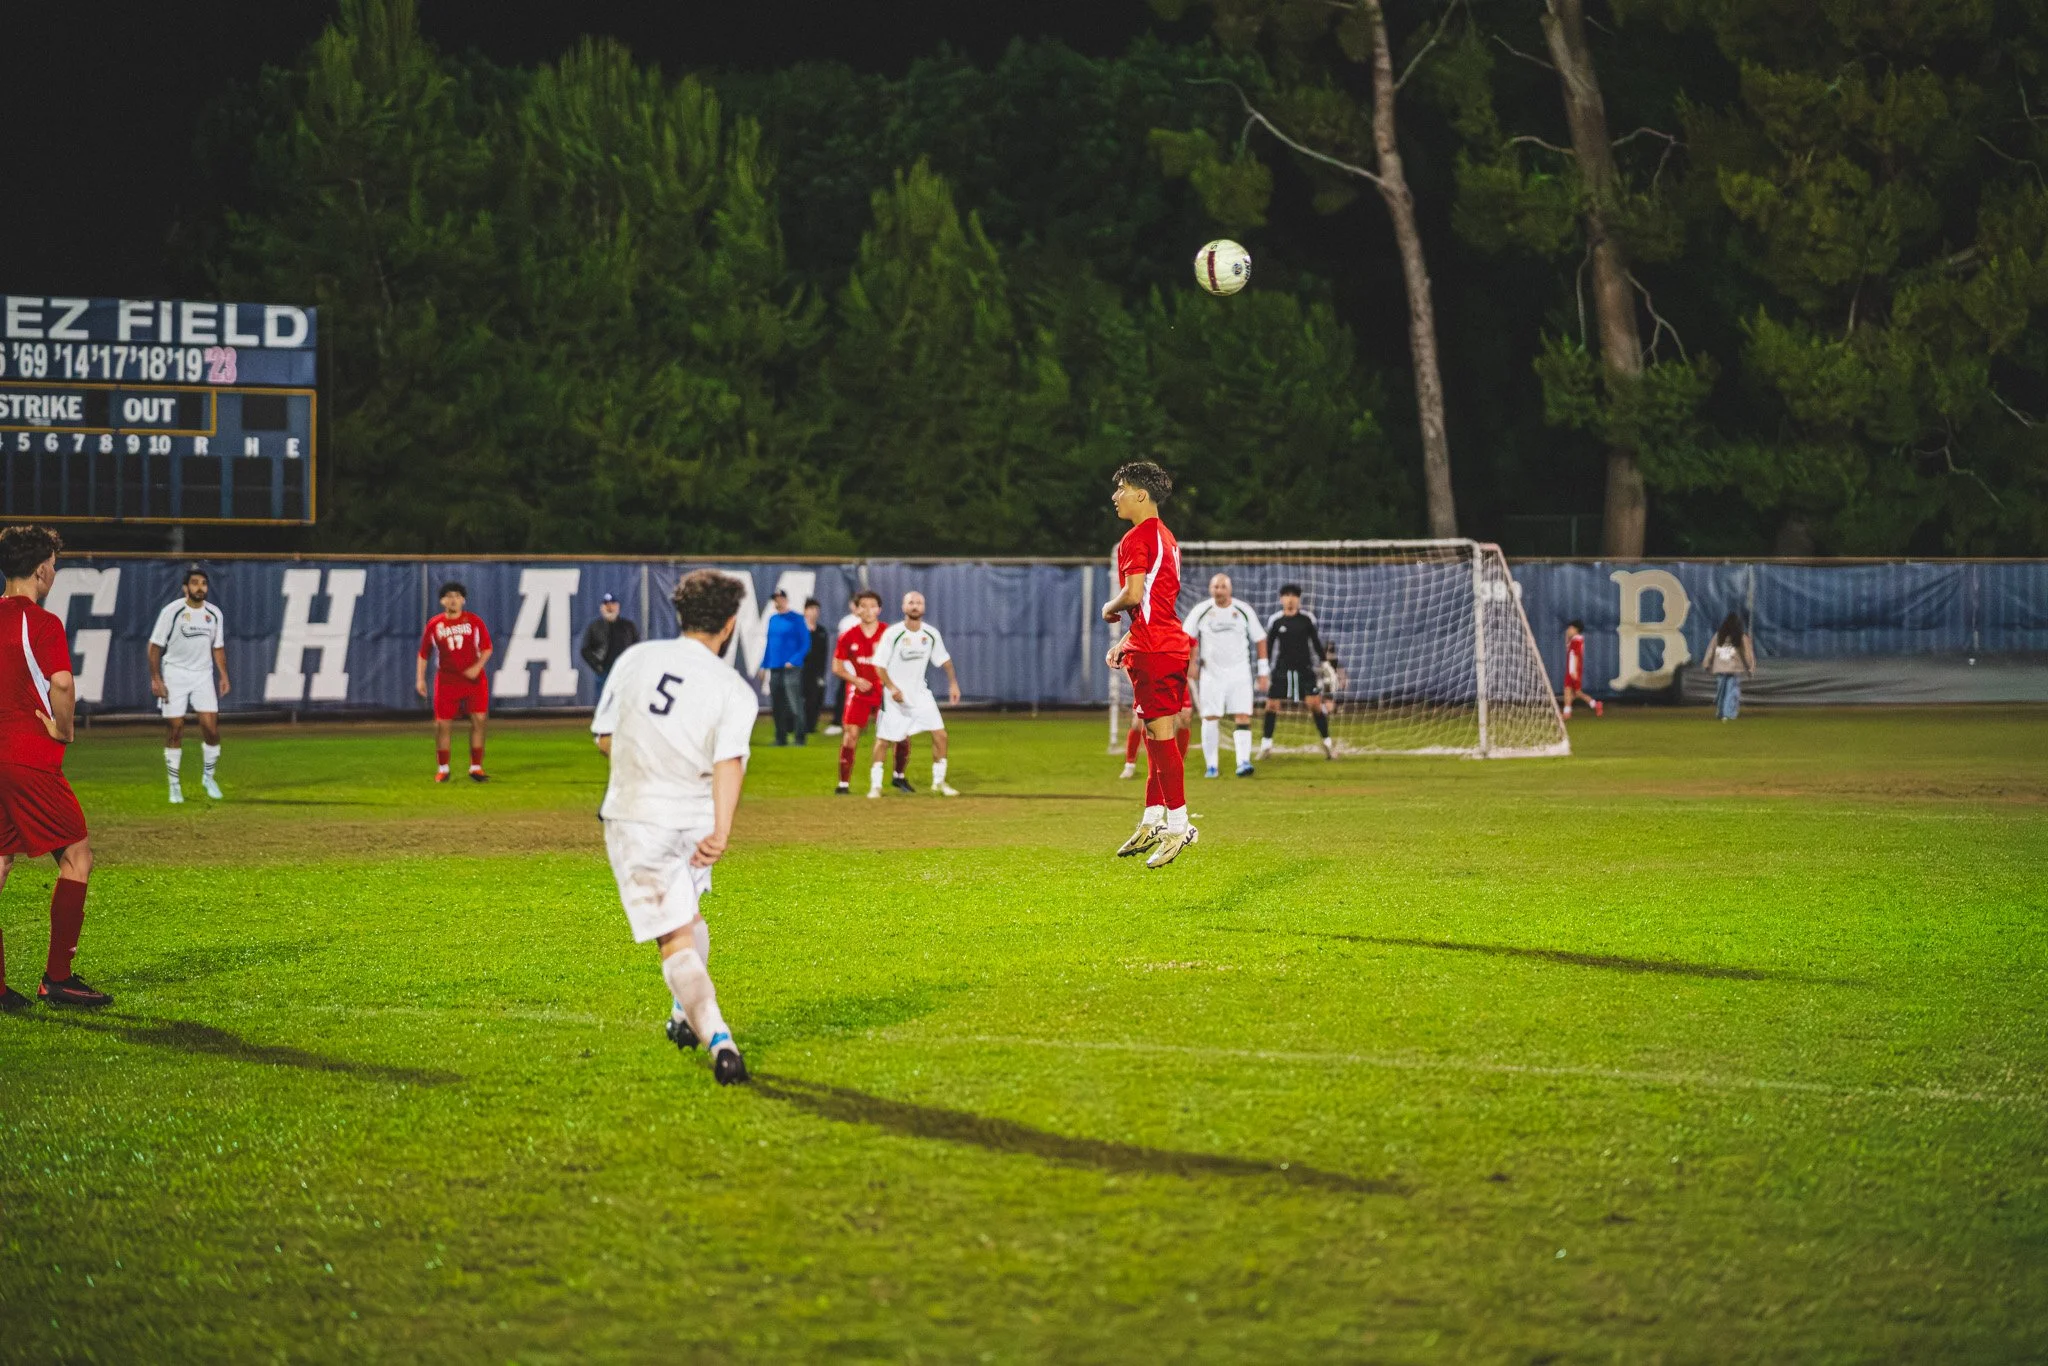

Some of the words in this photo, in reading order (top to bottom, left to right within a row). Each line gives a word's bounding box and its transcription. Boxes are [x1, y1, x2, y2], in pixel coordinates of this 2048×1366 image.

[118, 300, 308, 348] FIELD
[13, 342, 48, 378] '69
[54, 343, 89, 379] '14
[91, 344, 128, 379] '17
[130, 346, 166, 381] '18
[167, 347, 202, 382] '19
[0, 394, 83, 420] STRIKE
[123, 397, 176, 423] OUT
[18, 432, 31, 452] 5
[45, 432, 59, 453] 6
[72, 433, 86, 453] 7
[100, 433, 113, 454] 8
[126, 434, 140, 454] 9
[148, 435, 172, 456] 10
[194, 436, 209, 457] R
[244, 437, 260, 458] H
[286, 438, 300, 459] E
[447, 634, 464, 651] 17
[1609, 569, 1691, 691] B
[649, 673, 684, 715] 5
